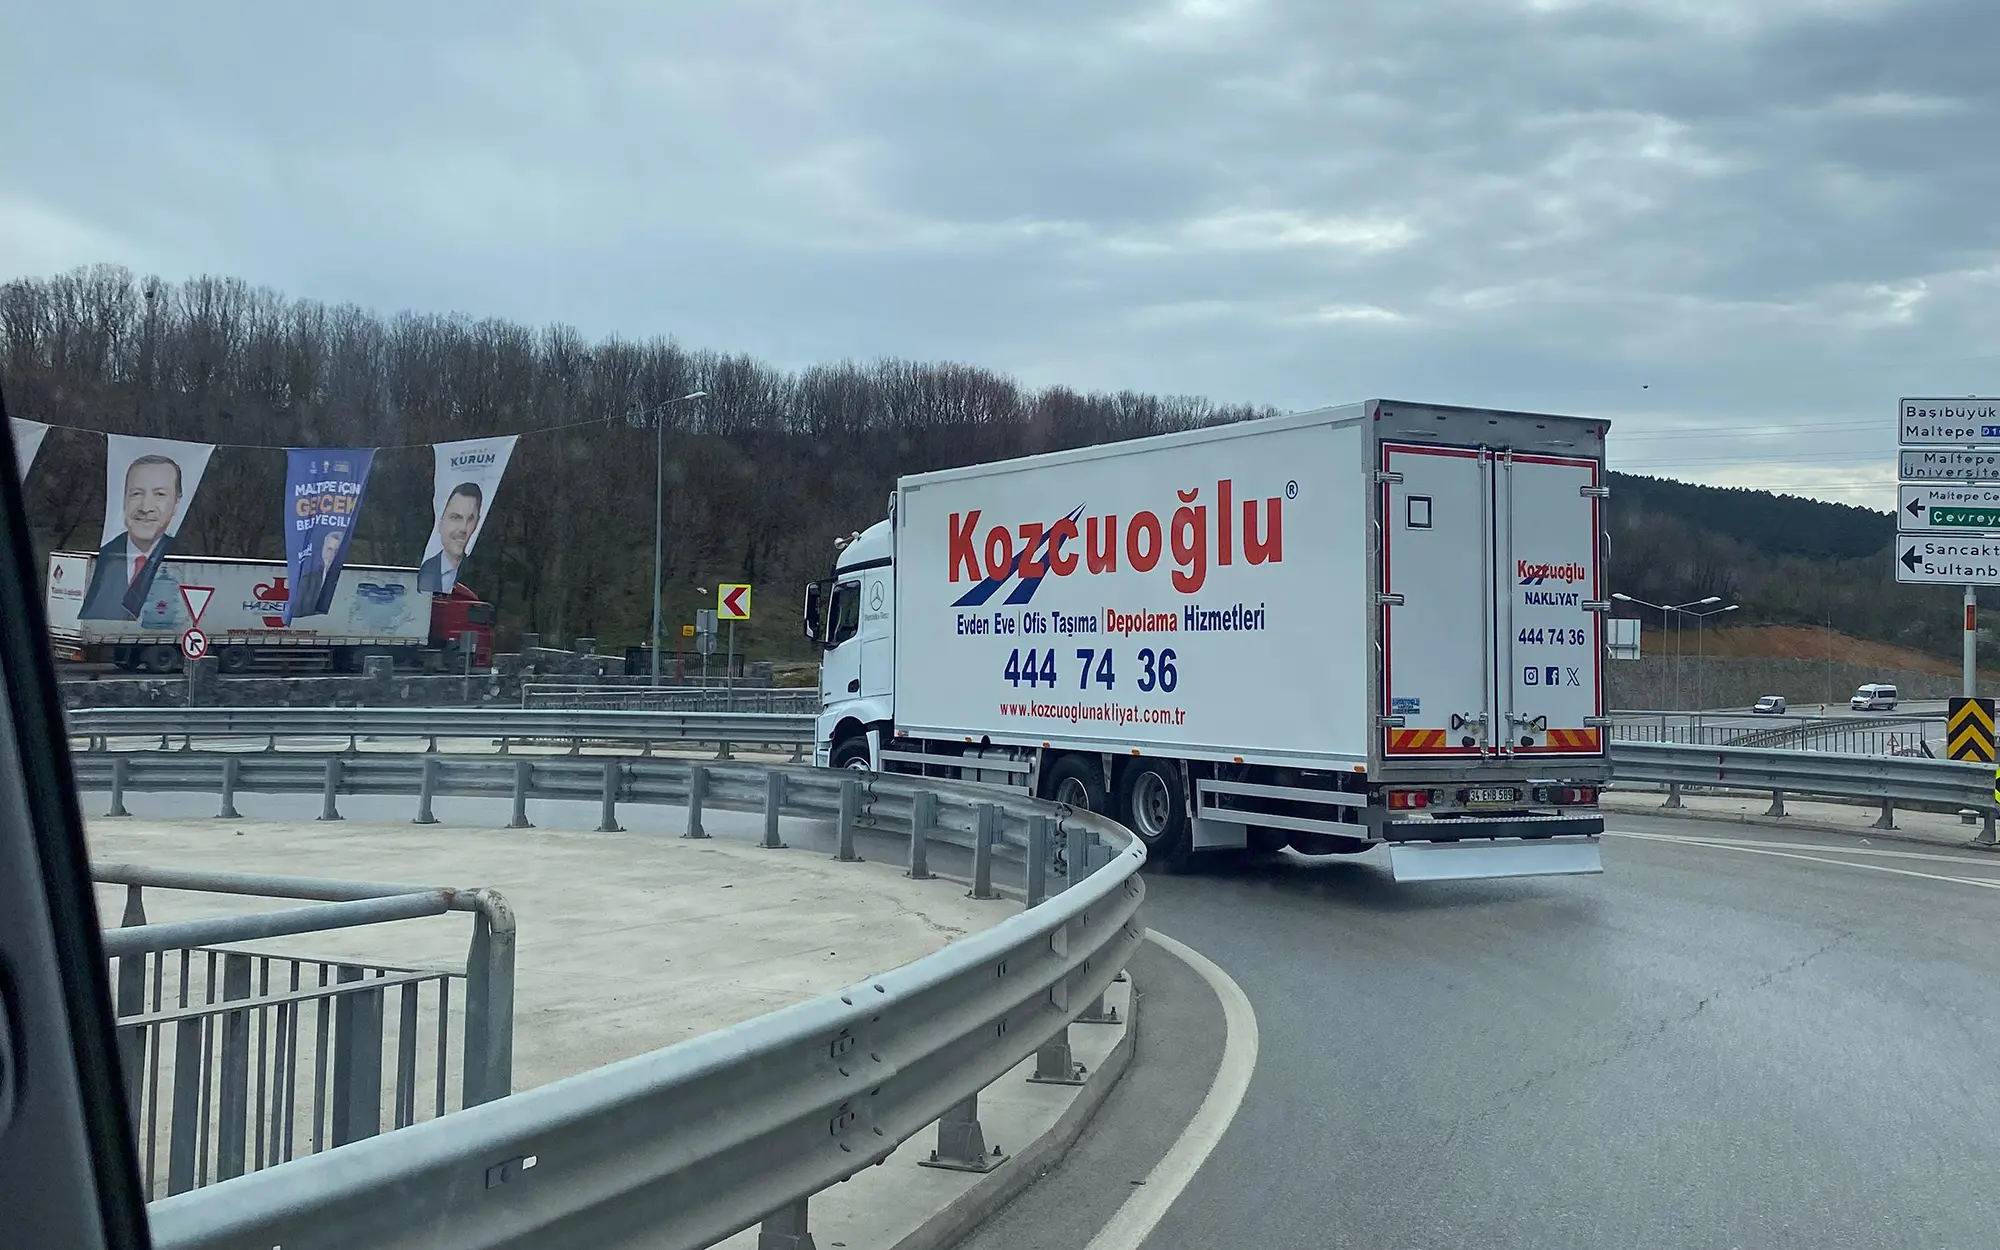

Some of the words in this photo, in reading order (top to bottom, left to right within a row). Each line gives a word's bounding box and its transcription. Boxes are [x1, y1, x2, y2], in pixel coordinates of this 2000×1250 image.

[1906, 406, 1996, 420] Başıbüyük
[1906, 425, 1975, 439] Maltepe
[1982, 427, 2000, 436] D1
[450, 453, 496, 467] KURUM
[1924, 453, 1996, 466] Maltepe
[1929, 491, 1979, 502] Maltepe
[949, 479, 1283, 594] Kozcuoğlu
[1517, 560, 1585, 584] Kozcuoğlu
[1924, 563, 1998, 577] Sultanb
[957, 613, 989, 635] Evden
[994, 612, 1015, 634] Eve
[1023, 612, 1047, 634] Ofis
[1052, 611, 1097, 637] Taşıma
[1107, 608, 1178, 637] Depolama
[1184, 603, 1265, 631] Hizmetleri
[1519, 628, 1544, 644] 444
[1548, 629, 1564, 645] 74
[1568, 629, 1585, 645] 36
[1004, 648, 1057, 688] 444
[1076, 648, 1115, 690] 74
[1137, 648, 1178, 692] 36
[1000, 700, 1186, 726] www.kozcuoglunakliyat.com.tr
[1470, 790, 1480, 800] 34
